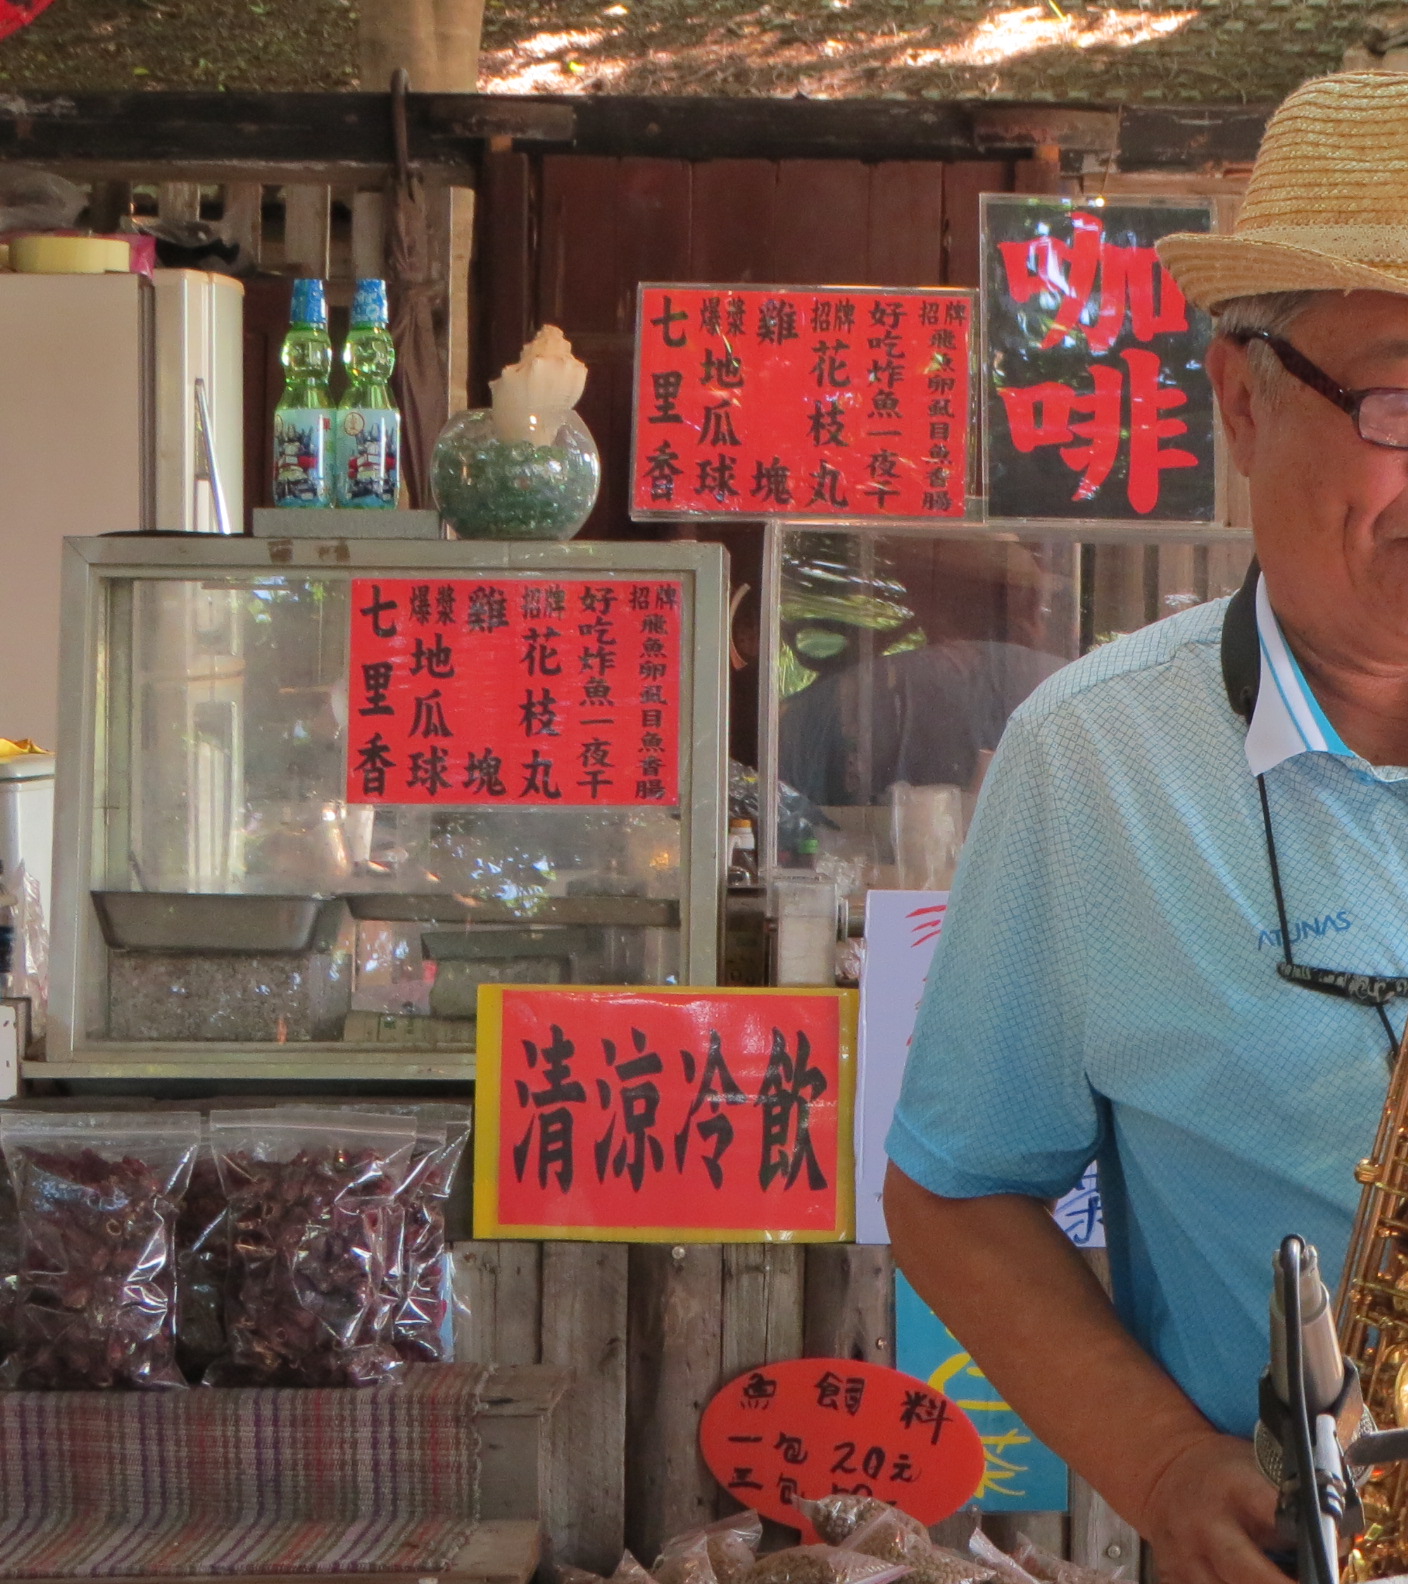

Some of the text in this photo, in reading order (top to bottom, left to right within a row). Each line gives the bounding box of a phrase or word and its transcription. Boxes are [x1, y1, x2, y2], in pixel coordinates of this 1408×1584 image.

[643, 296, 685, 502] 七里香
[997, 209, 1199, 515] 咖啡
[353, 584, 398, 797] 七里香
[512, 1023, 829, 1194] 清涼冷飲
[739, 1372, 954, 1445] 魚飼料
